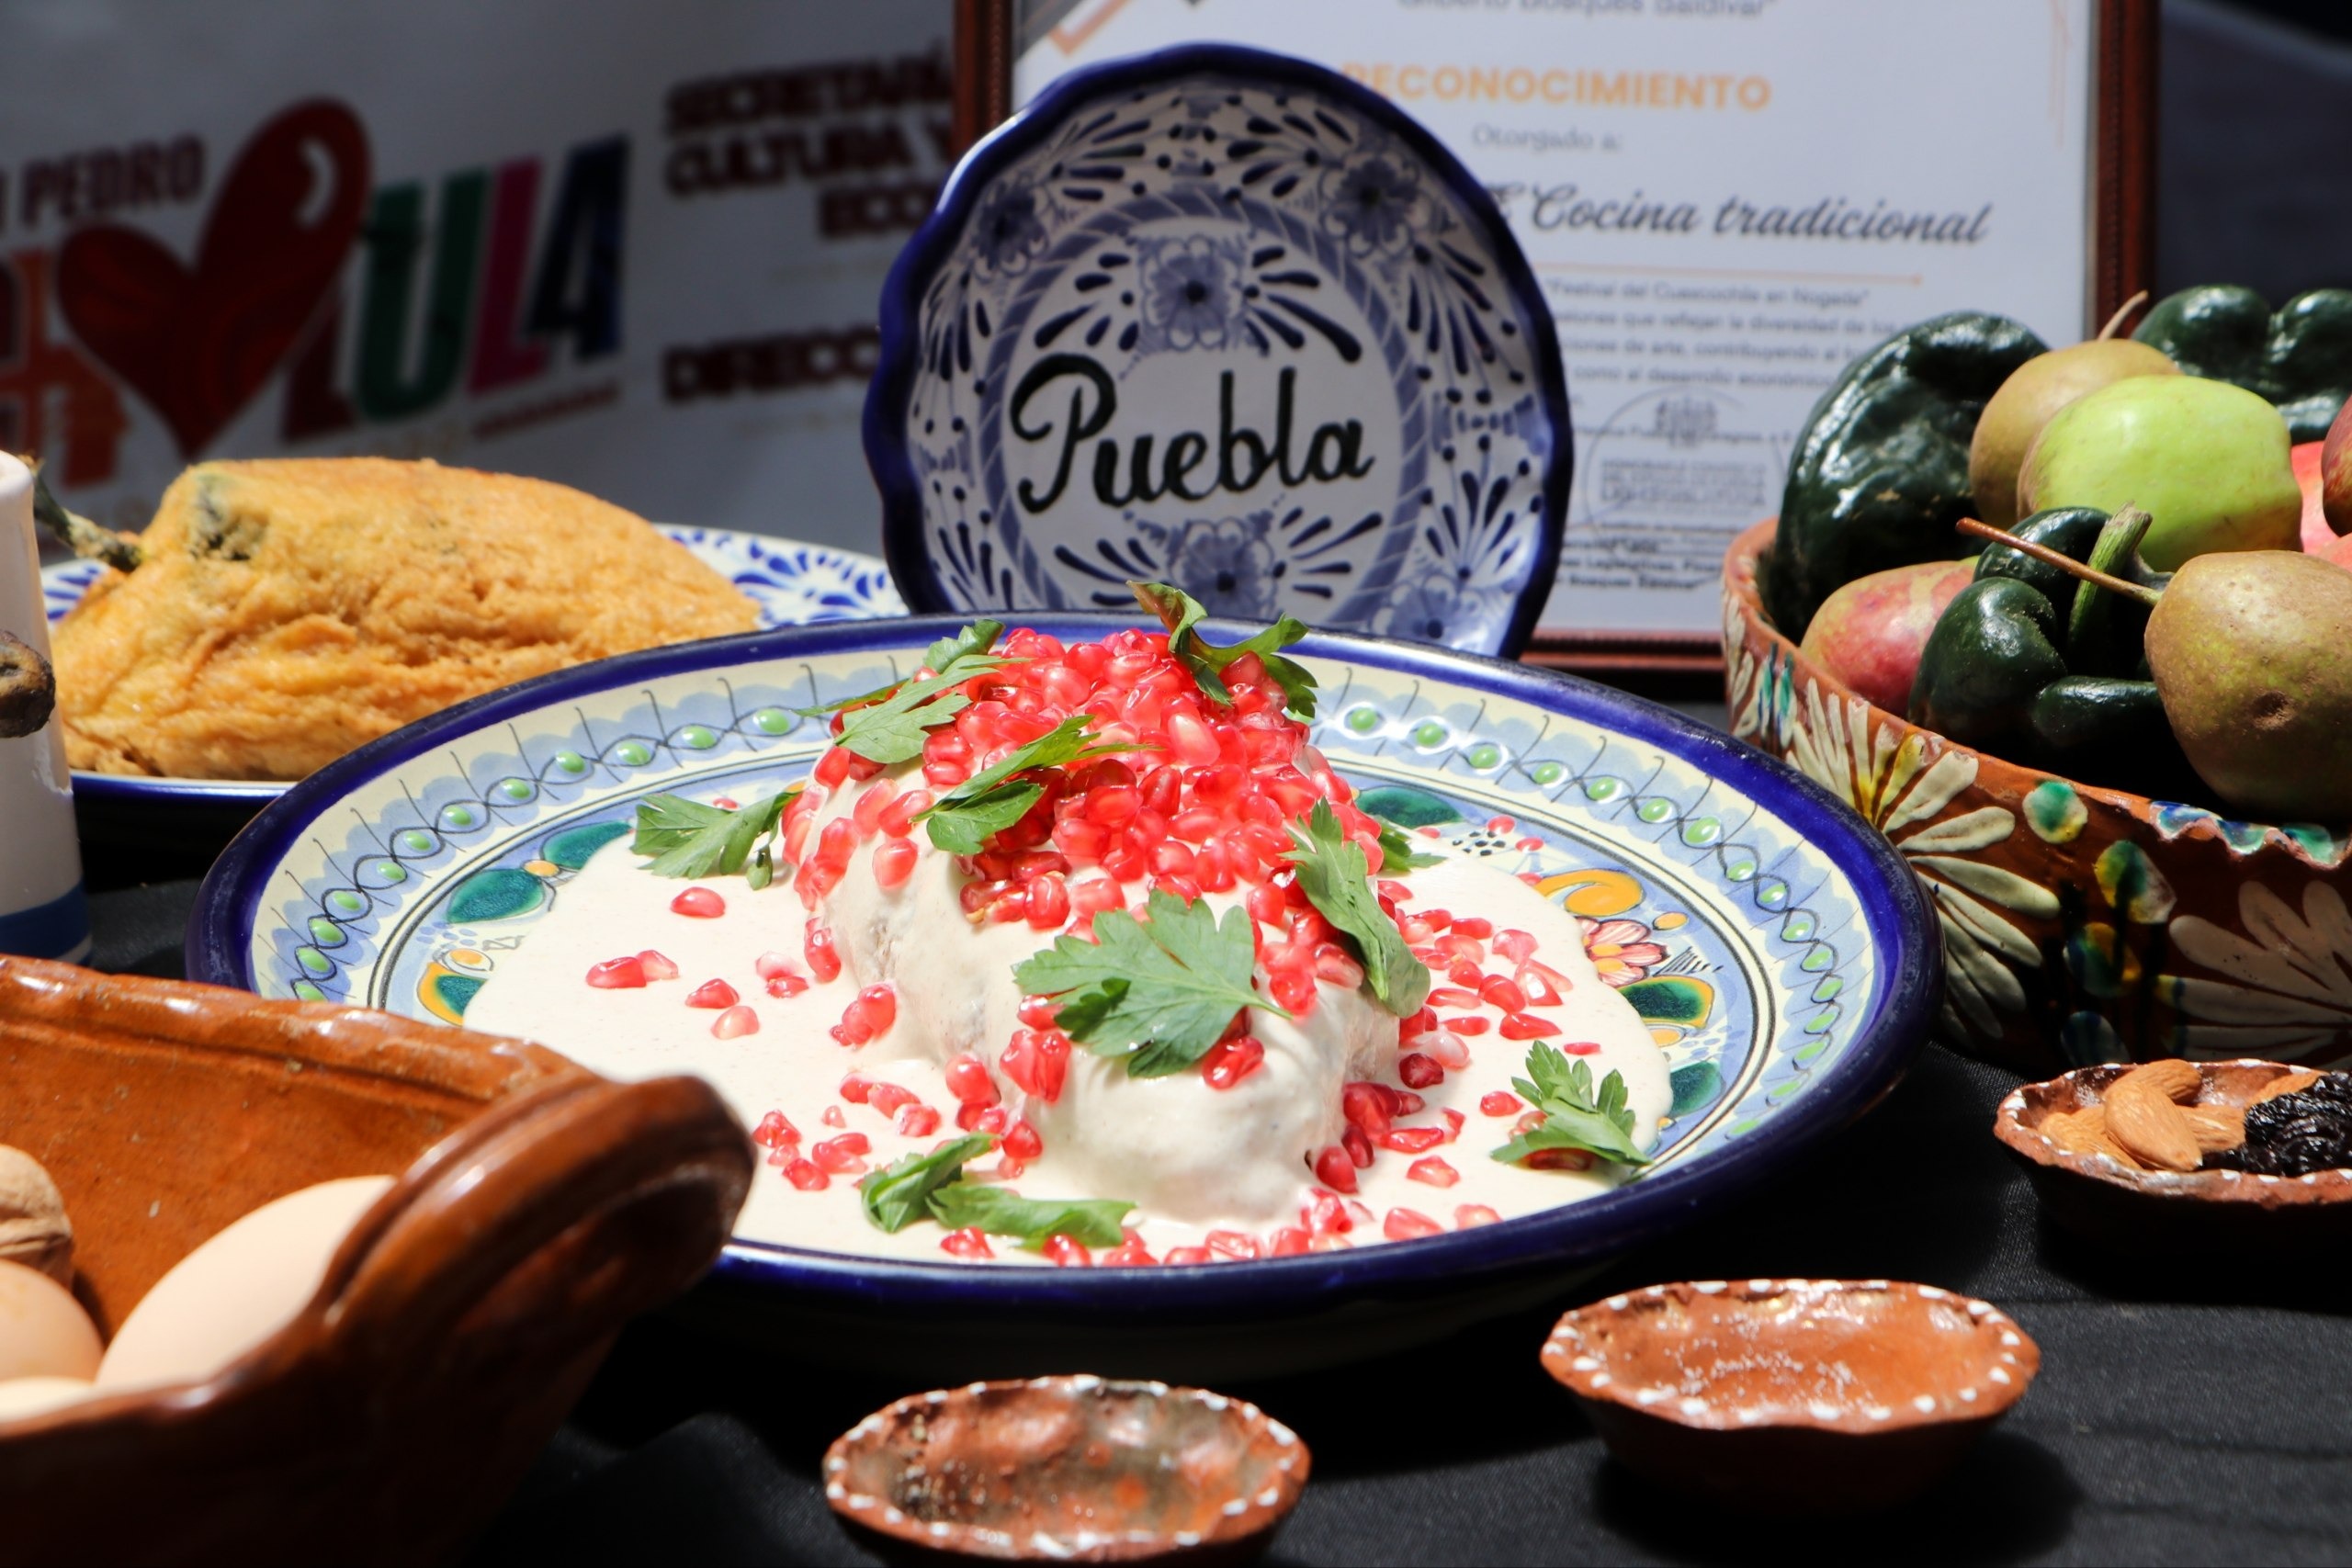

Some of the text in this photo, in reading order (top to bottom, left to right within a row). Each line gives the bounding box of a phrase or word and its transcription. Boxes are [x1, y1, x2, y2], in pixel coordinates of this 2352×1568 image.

[1471, 121, 1593, 154] Otorgado
[22, 133, 207, 226] PEDRO
[1532, 181, 1700, 234] Cocina
[1713, 194, 1993, 245] tradicional
[1011, 352, 1375, 514] Puebla
